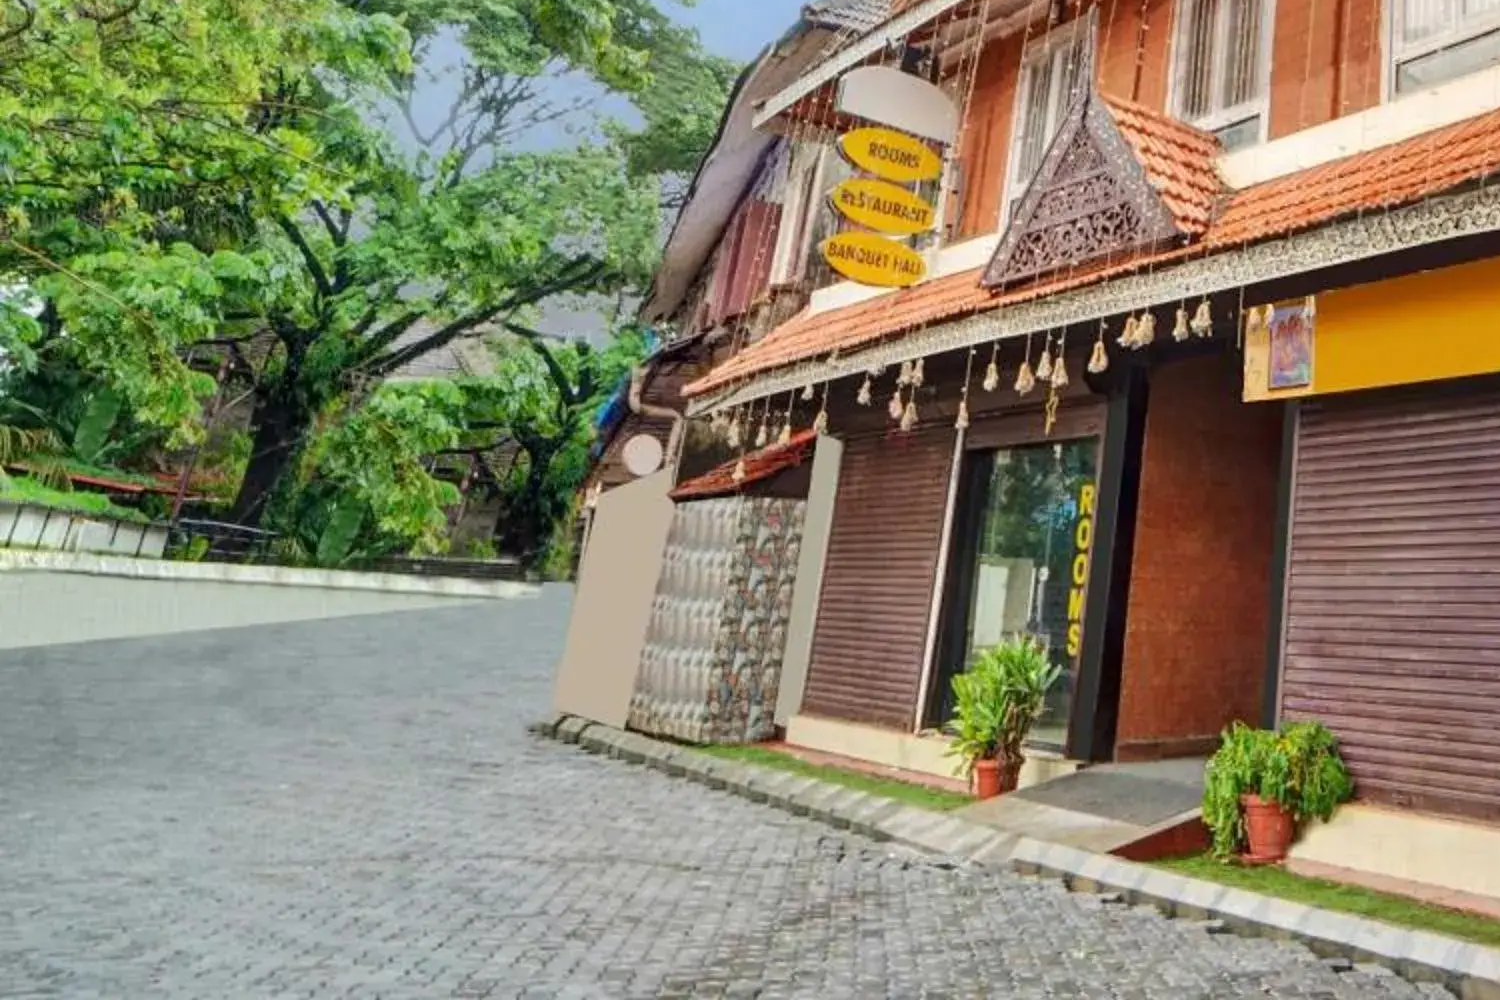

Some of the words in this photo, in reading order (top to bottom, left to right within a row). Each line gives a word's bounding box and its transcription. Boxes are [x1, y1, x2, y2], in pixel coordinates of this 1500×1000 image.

[869, 141, 920, 169] ROOMS
[827, 241, 888, 268] BANQUET
[894, 255, 922, 275] HALL
[1066, 484, 1096, 657] ROOMS
